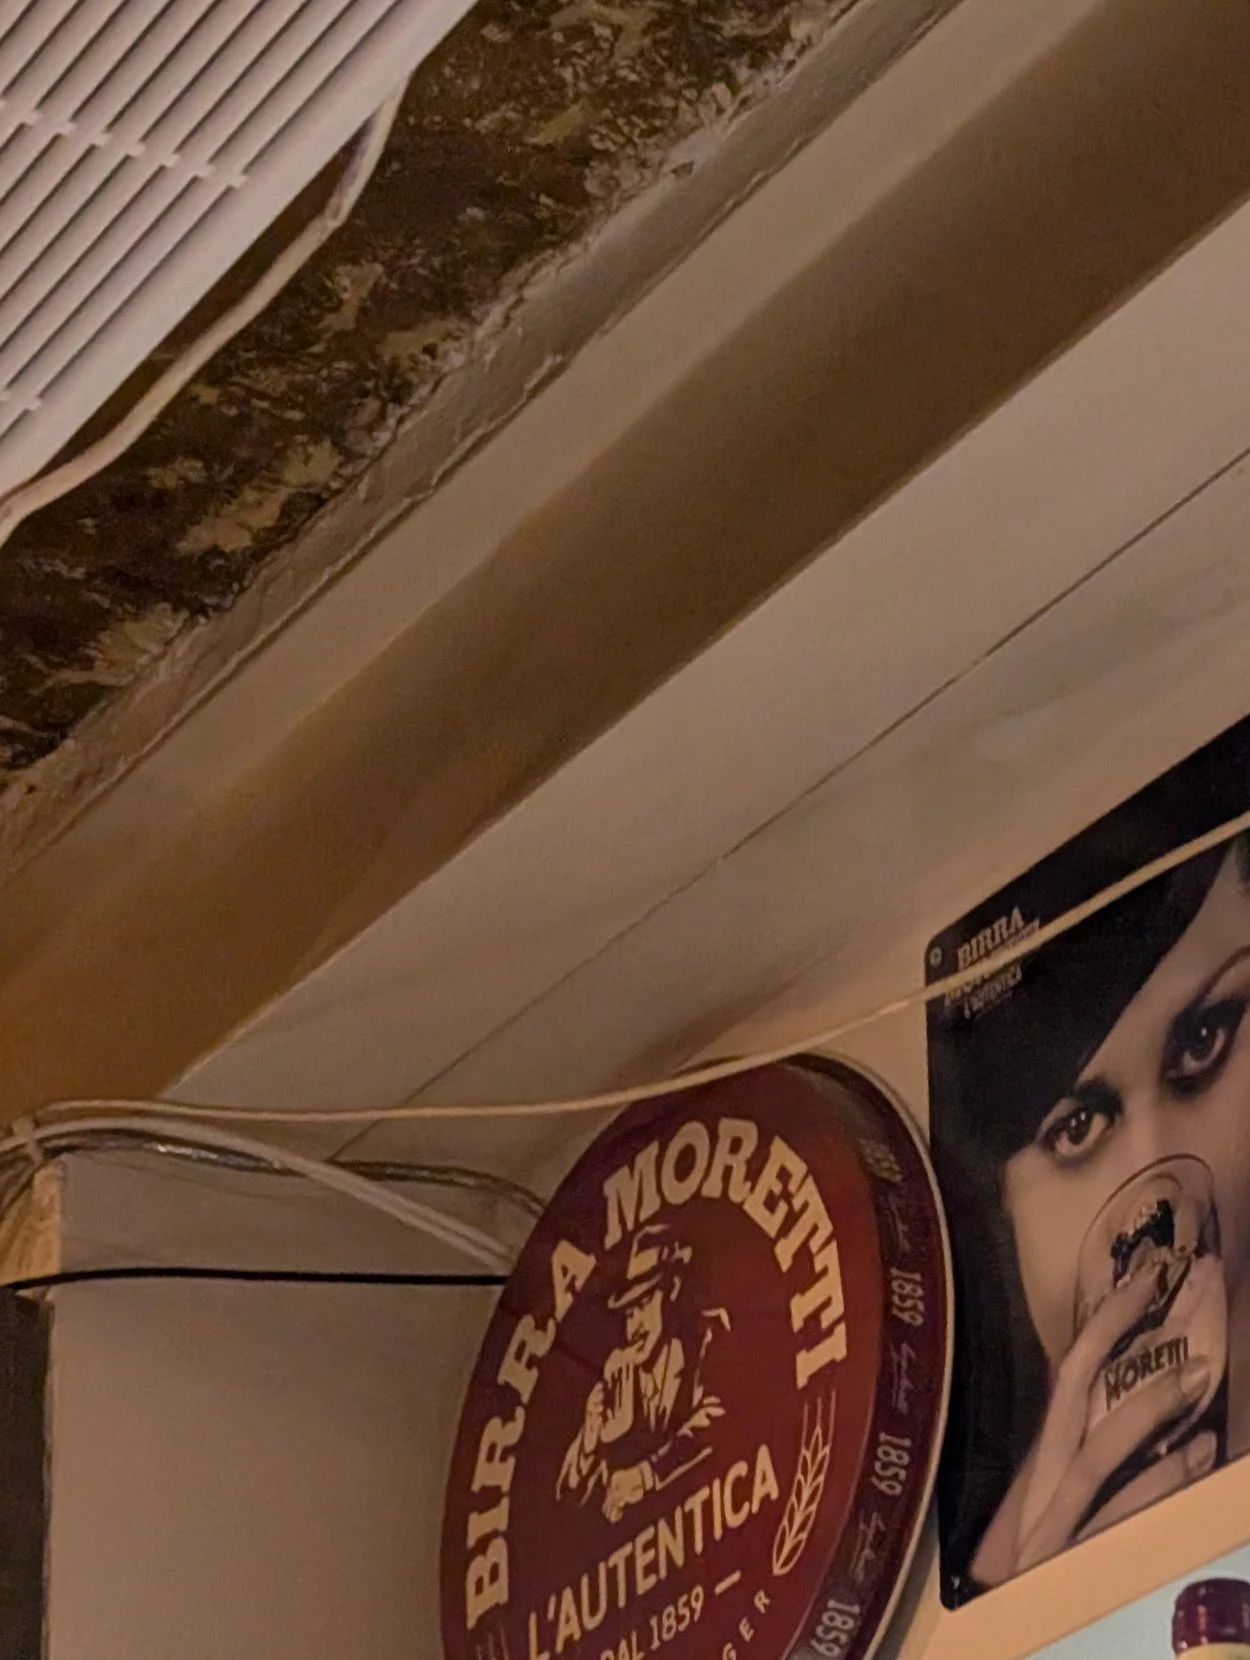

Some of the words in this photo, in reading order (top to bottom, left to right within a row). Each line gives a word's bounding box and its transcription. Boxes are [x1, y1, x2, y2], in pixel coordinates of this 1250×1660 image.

[957, 904, 1025, 972] BIRRA
[889, 1267, 925, 1327] 1859
[466, 1240, 597, 1629] BIRRA
[603, 1116, 848, 1390] MORETTI
[870, 1431, 912, 1496] 1859
[650, 1585, 704, 1650] 1859
[810, 1599, 861, 1657] 1859
